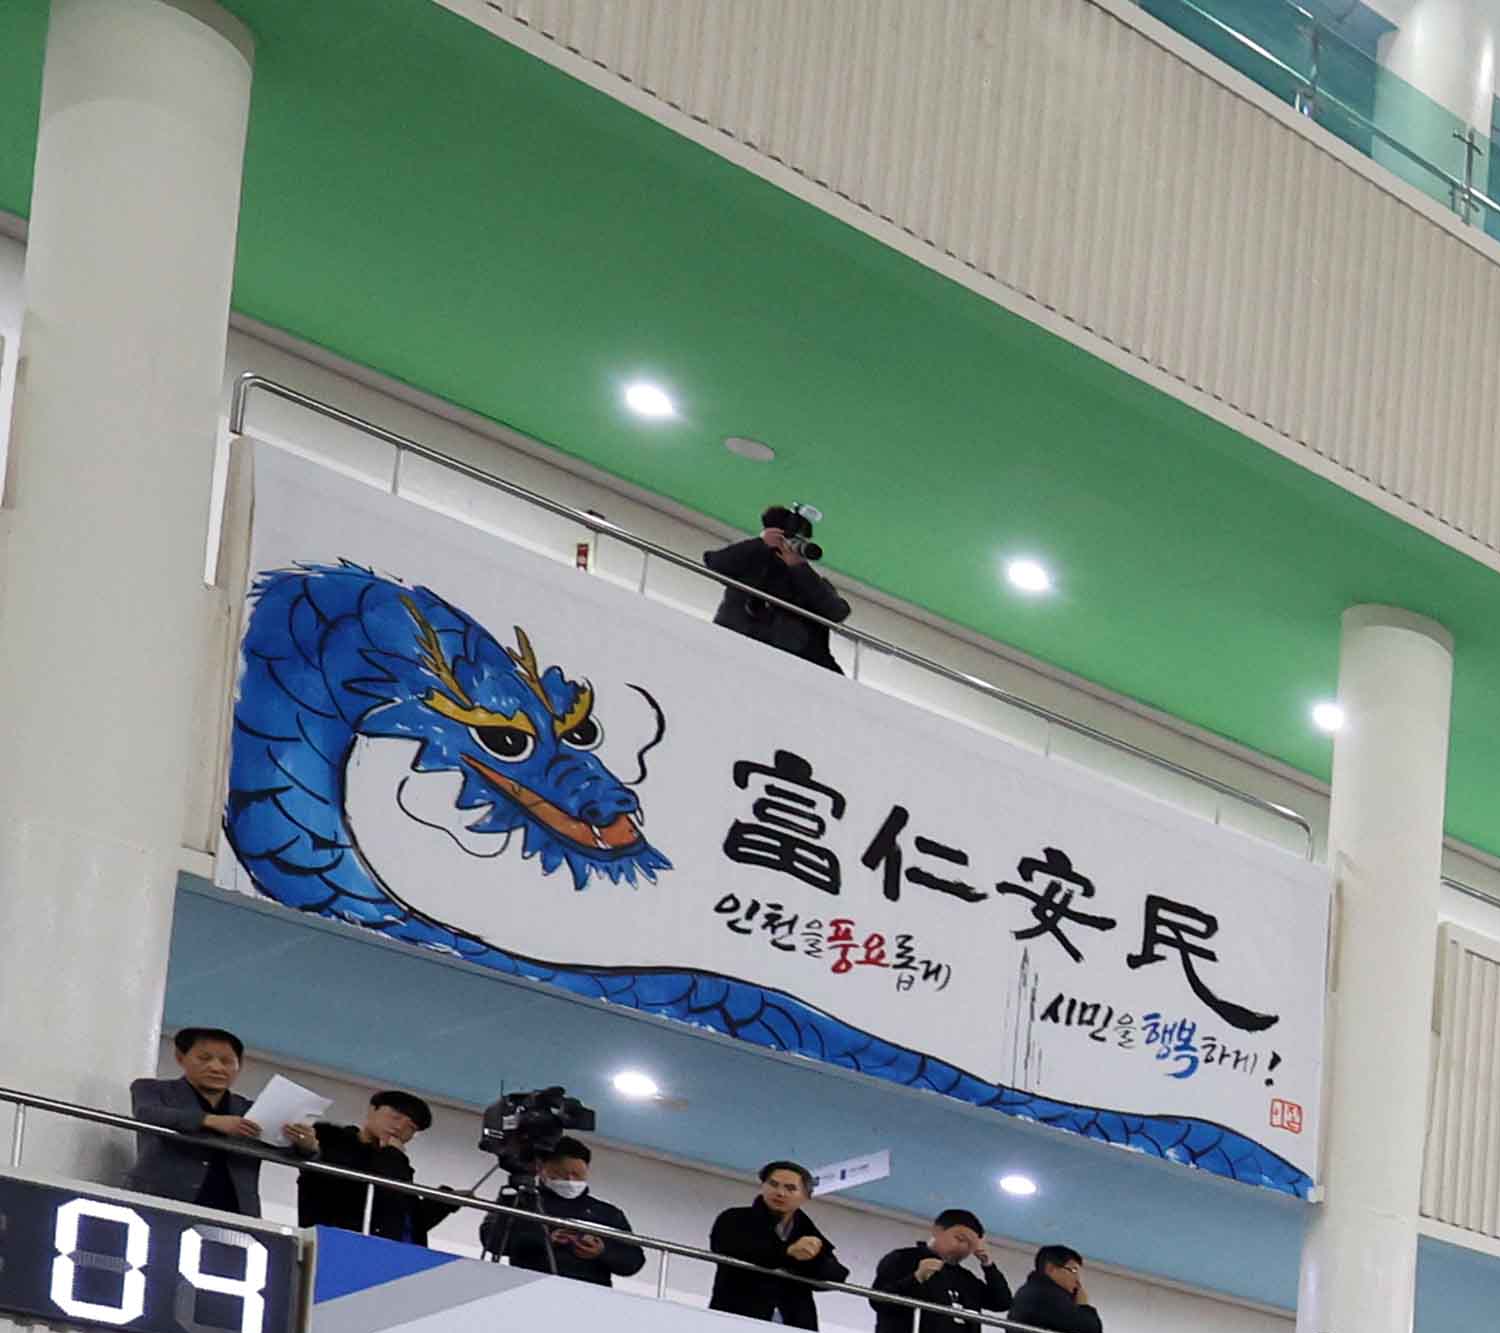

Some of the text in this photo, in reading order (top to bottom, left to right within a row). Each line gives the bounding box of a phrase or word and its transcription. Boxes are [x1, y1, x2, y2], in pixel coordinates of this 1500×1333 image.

[722, 749, 1280, 1034] 富仁安民
[713, 893, 824, 959] 인천을
[1040, 993, 1137, 1049] 시민을
